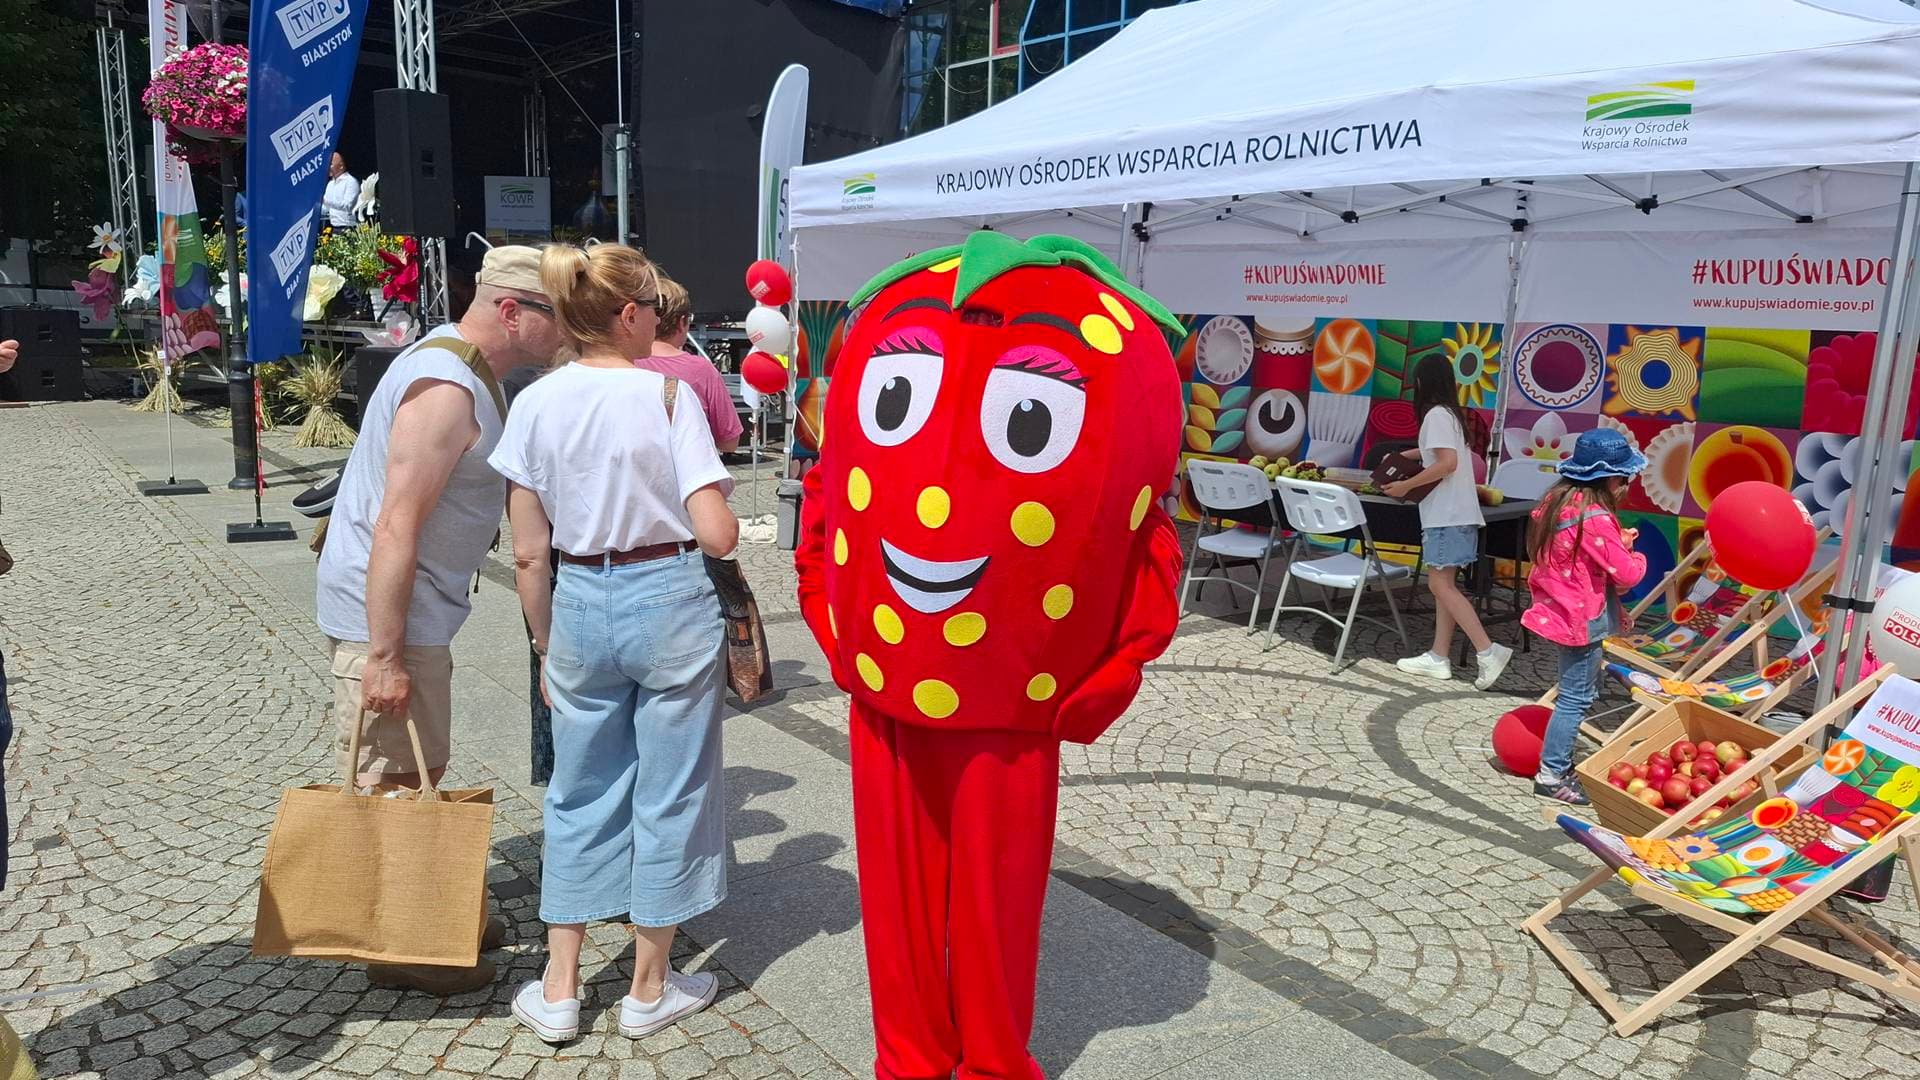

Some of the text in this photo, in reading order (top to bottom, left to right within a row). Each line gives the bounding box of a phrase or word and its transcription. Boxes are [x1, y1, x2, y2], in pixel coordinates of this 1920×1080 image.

[301, 24, 353, 68] BIAŁYSTOK
[1582, 120, 1690, 139] Krajowy Ośrodek
[1582, 136, 1688, 152] Wsparcia Rolnictwa
[936, 119, 1422, 194] KRAJOWY OŚRODEK WSPARCIA ROLNICTWA
[500, 192, 535, 204] KOWR
[1243, 260, 1387, 286] #KUPUJŚWIADOMIE
[1691, 252, 1914, 286] #KUPUJŚWIADO
[1246, 293, 1349, 305] www.kupujswiadomie.gov.pl
[1692, 297, 1875, 313] www.kupujswiadomie.gov.pl
[1876, 704, 1920, 735] #KUPUJ
